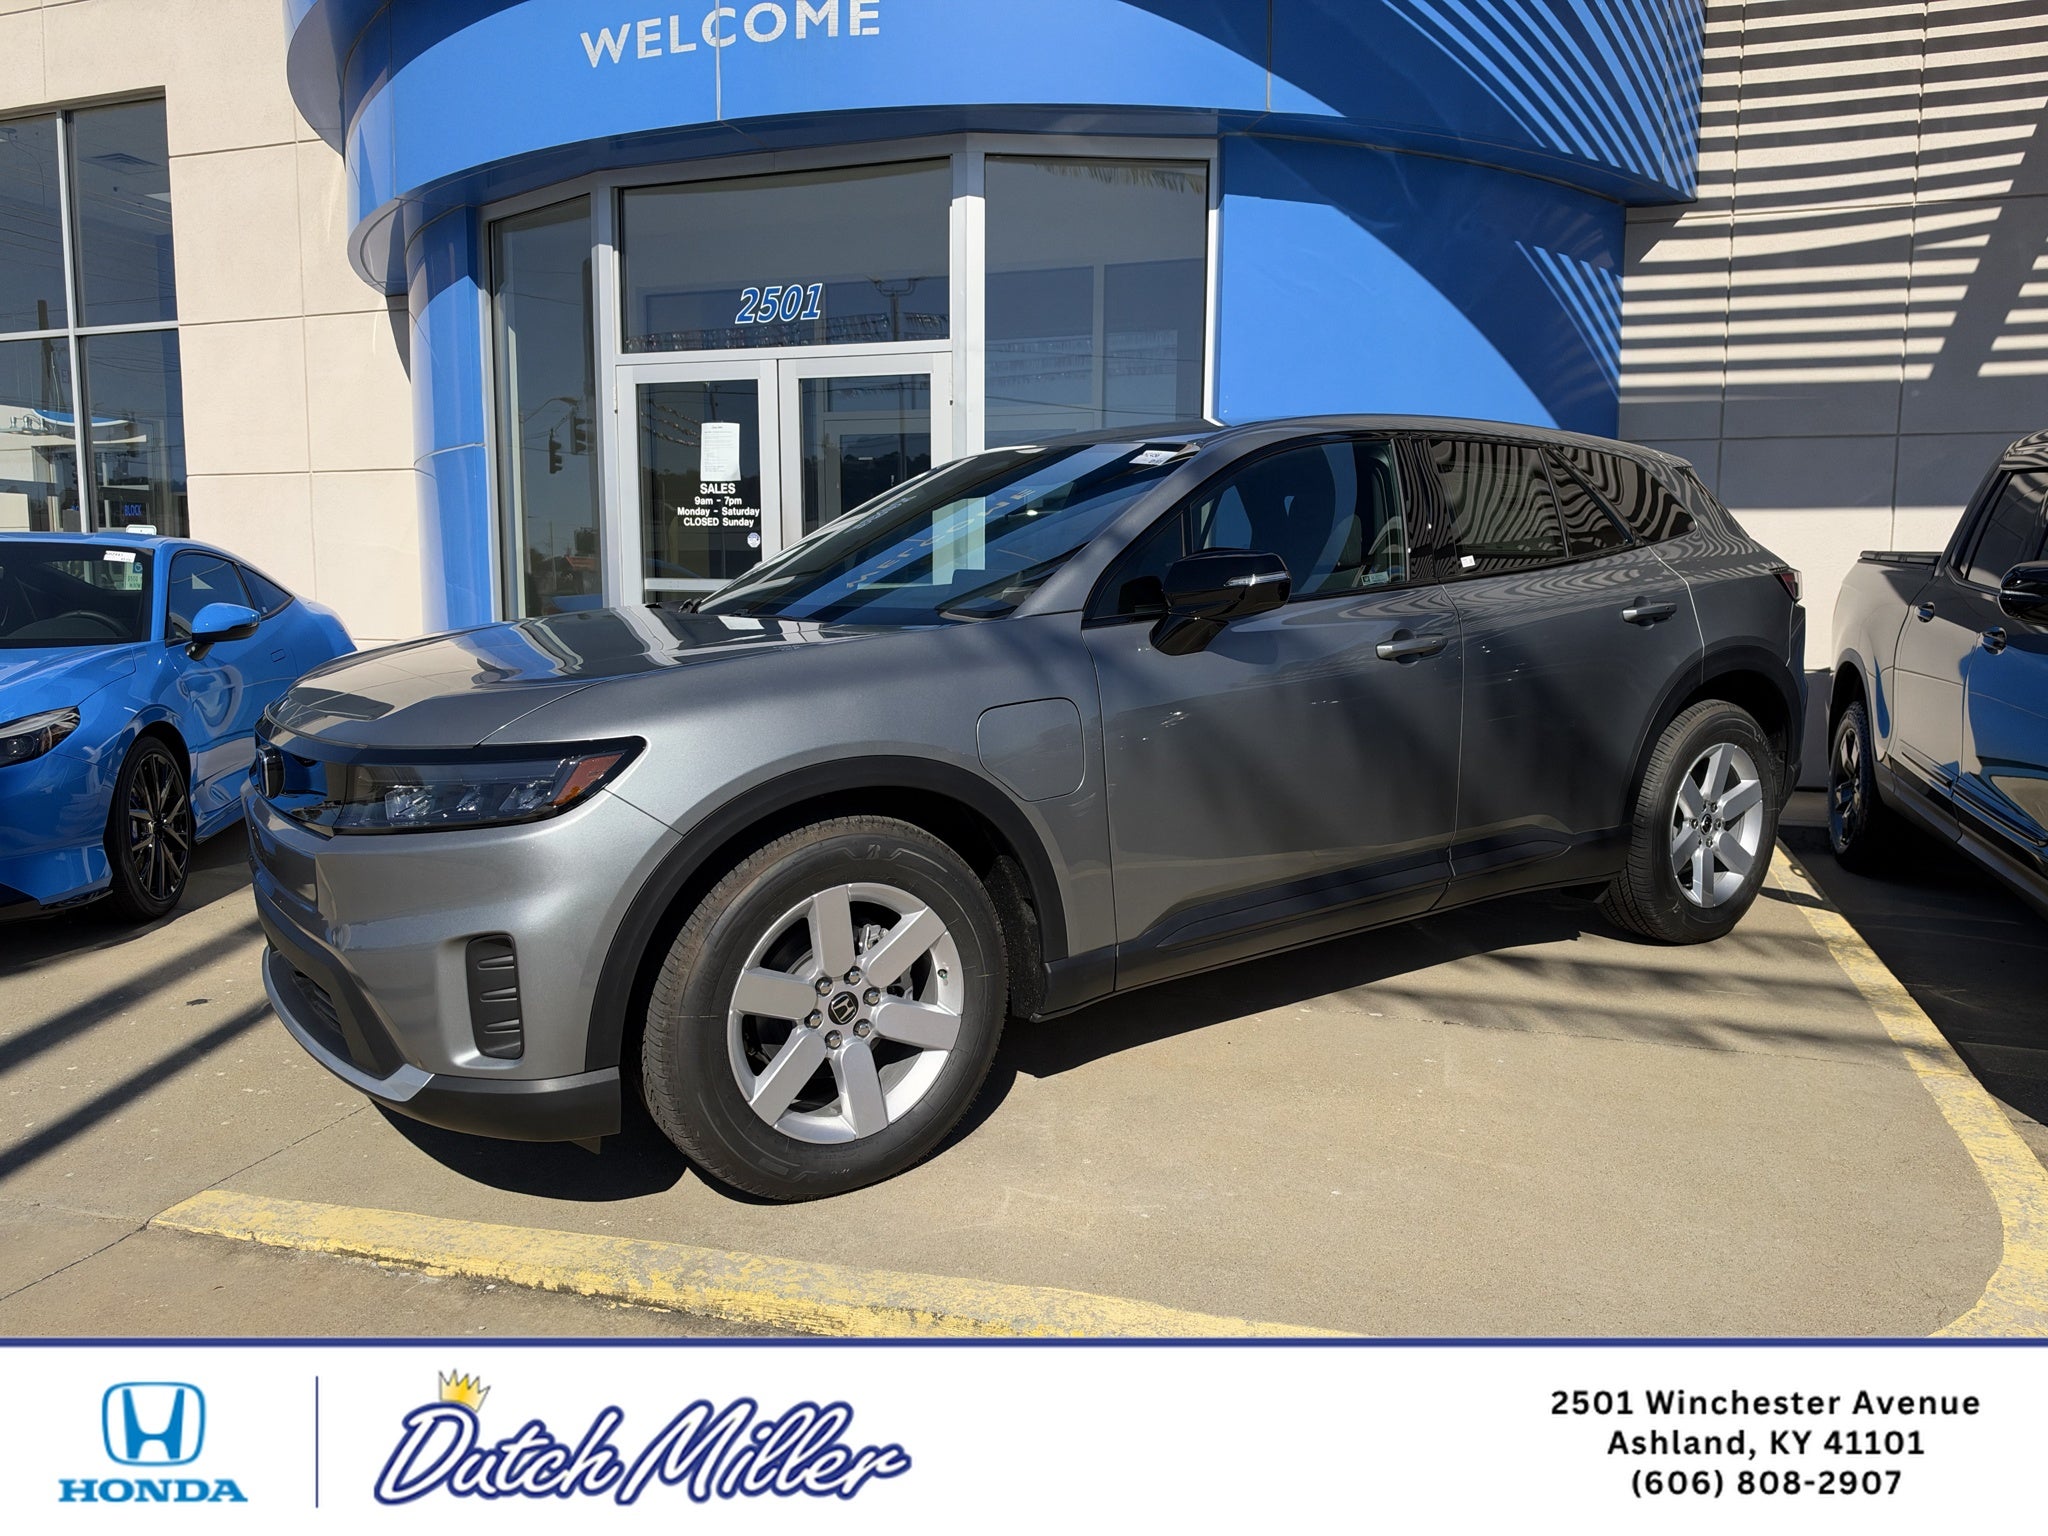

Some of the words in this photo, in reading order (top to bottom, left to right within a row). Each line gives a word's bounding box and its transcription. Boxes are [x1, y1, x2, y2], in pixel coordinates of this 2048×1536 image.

[580, 0, 880, 68] WELCOME
[734, 282, 823, 324] 2501
[700, 483, 736, 495] SALES
[694, 496, 714, 506] 9am
[724, 496, 742, 507] 7pm
[124, 503, 142, 516] BLOCK
[677, 507, 711, 518] Monday
[721, 507, 760, 518] Saturday
[683, 517, 720, 527] CLOSED
[722, 517, 755, 529] Sunday
